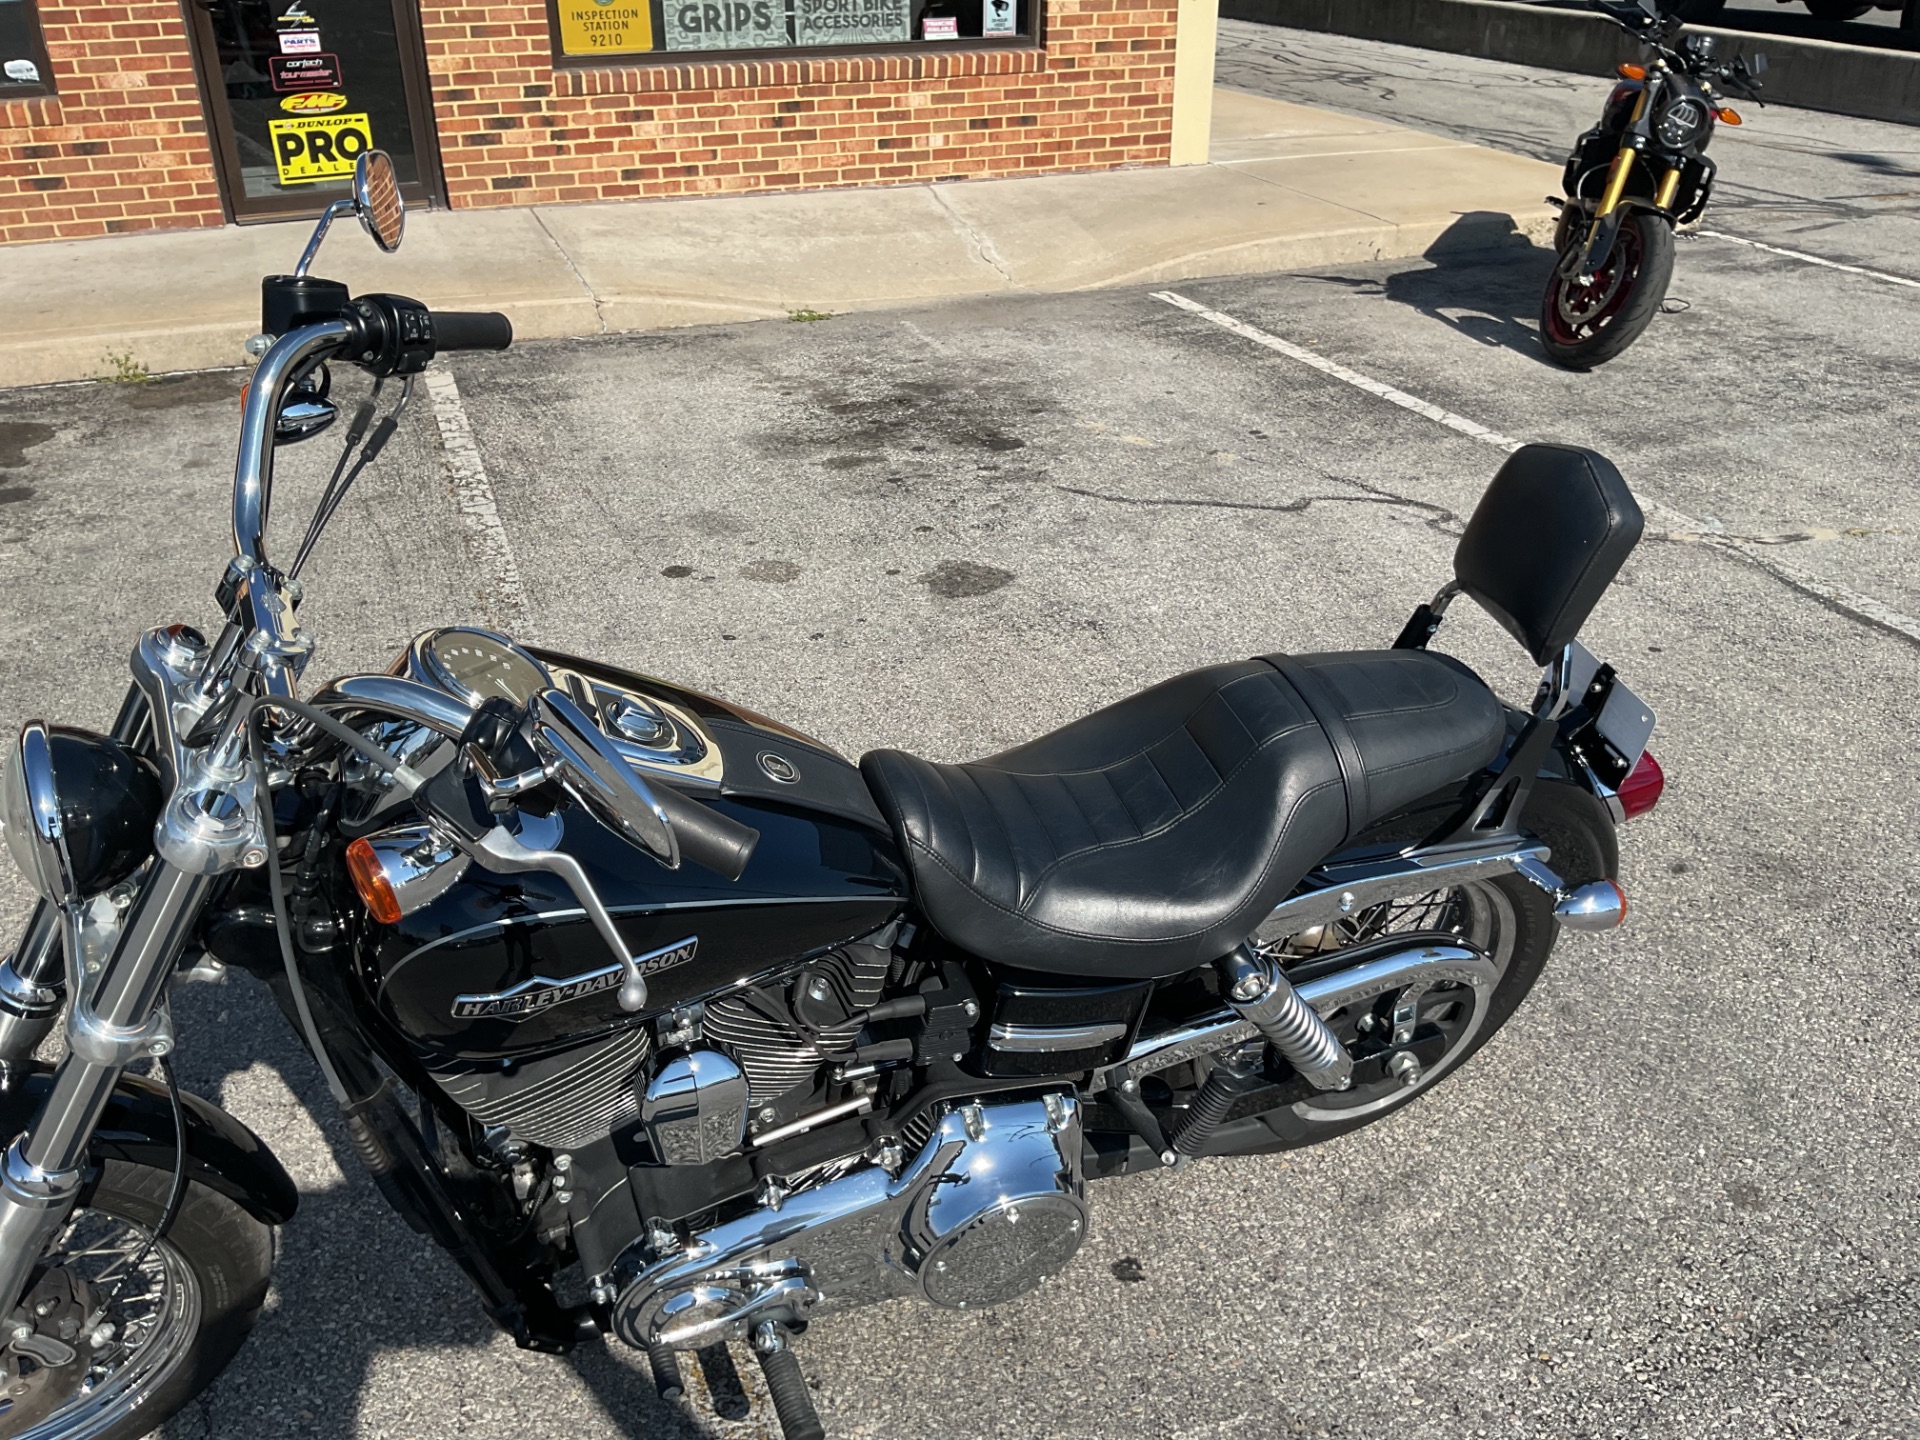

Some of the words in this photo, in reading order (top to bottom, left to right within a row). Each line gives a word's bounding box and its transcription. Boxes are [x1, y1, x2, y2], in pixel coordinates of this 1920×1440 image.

[571, 9, 639, 21] INSPECTION
[678, 1, 772, 33] GRIPS
[803, 12, 903, 31] ACCESSORIES
[583, 20, 629, 31] STATION
[590, 33, 623, 46] 9210
[286, 59, 323, 68] cortech
[281, 94, 346, 109] FMF
[296, 118, 352, 128] DUNLOP
[276, 127, 368, 166] PRO
[282, 162, 357, 175] DEALE
[461, 945, 691, 1016] HARLEY-DAVDSON
